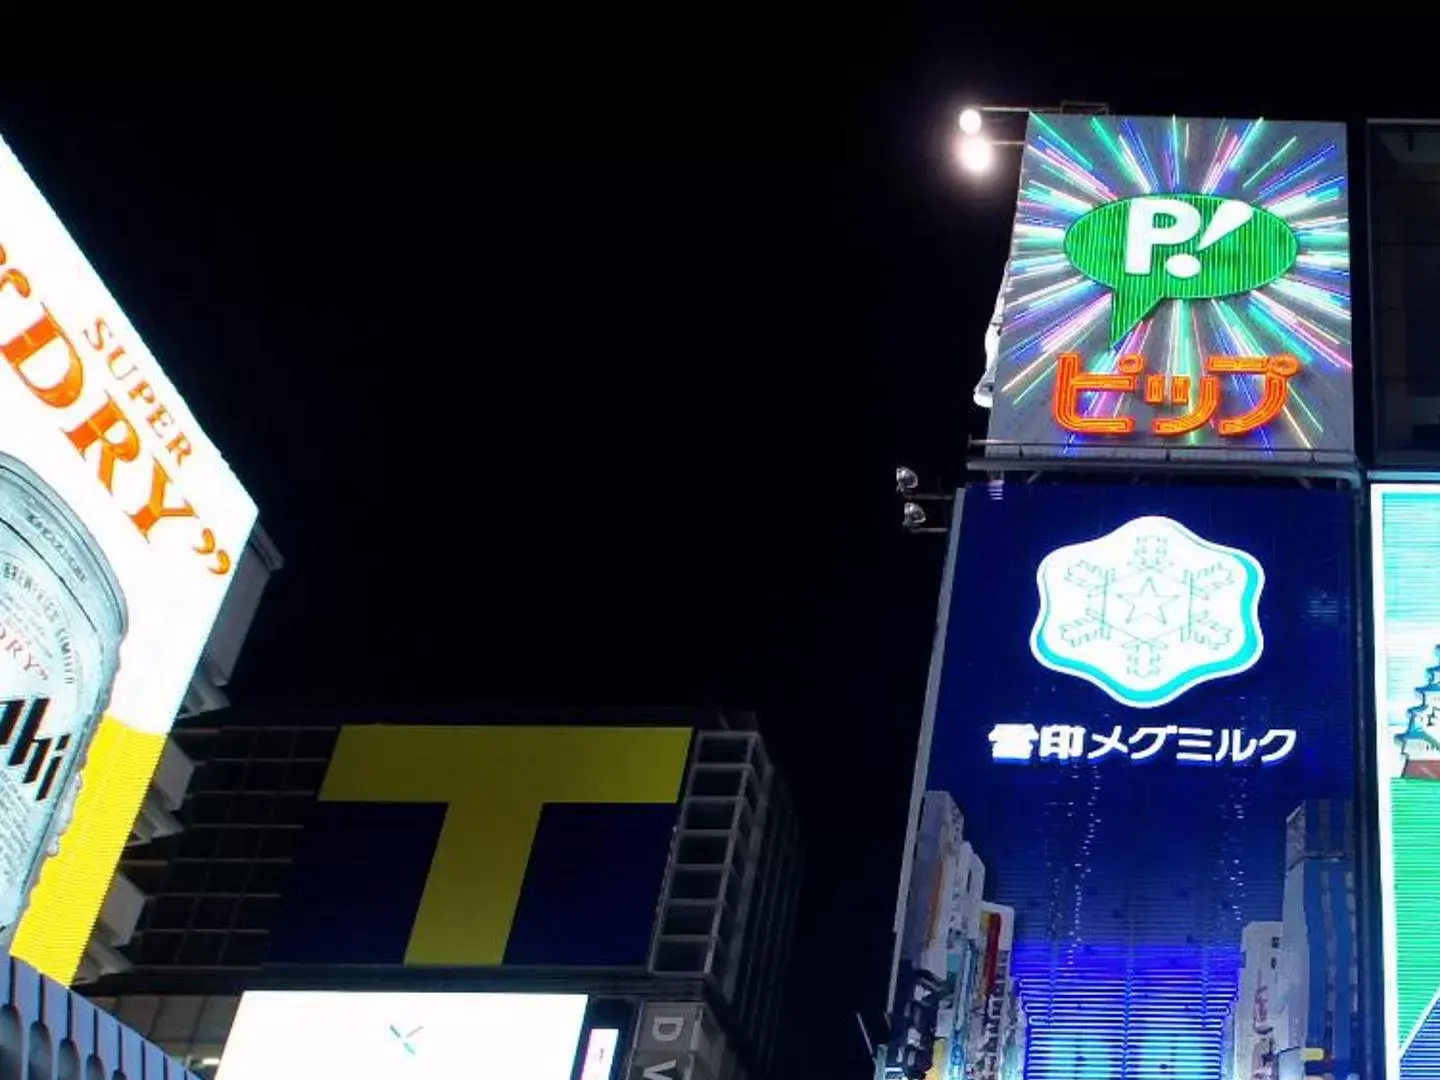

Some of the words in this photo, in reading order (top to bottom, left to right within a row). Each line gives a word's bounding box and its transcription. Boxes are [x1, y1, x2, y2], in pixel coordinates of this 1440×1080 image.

[83, 317, 194, 468] SUPER
[1050, 352, 1301, 438] ピップ
[986, 722, 1299, 763] 雪印メグミルク
